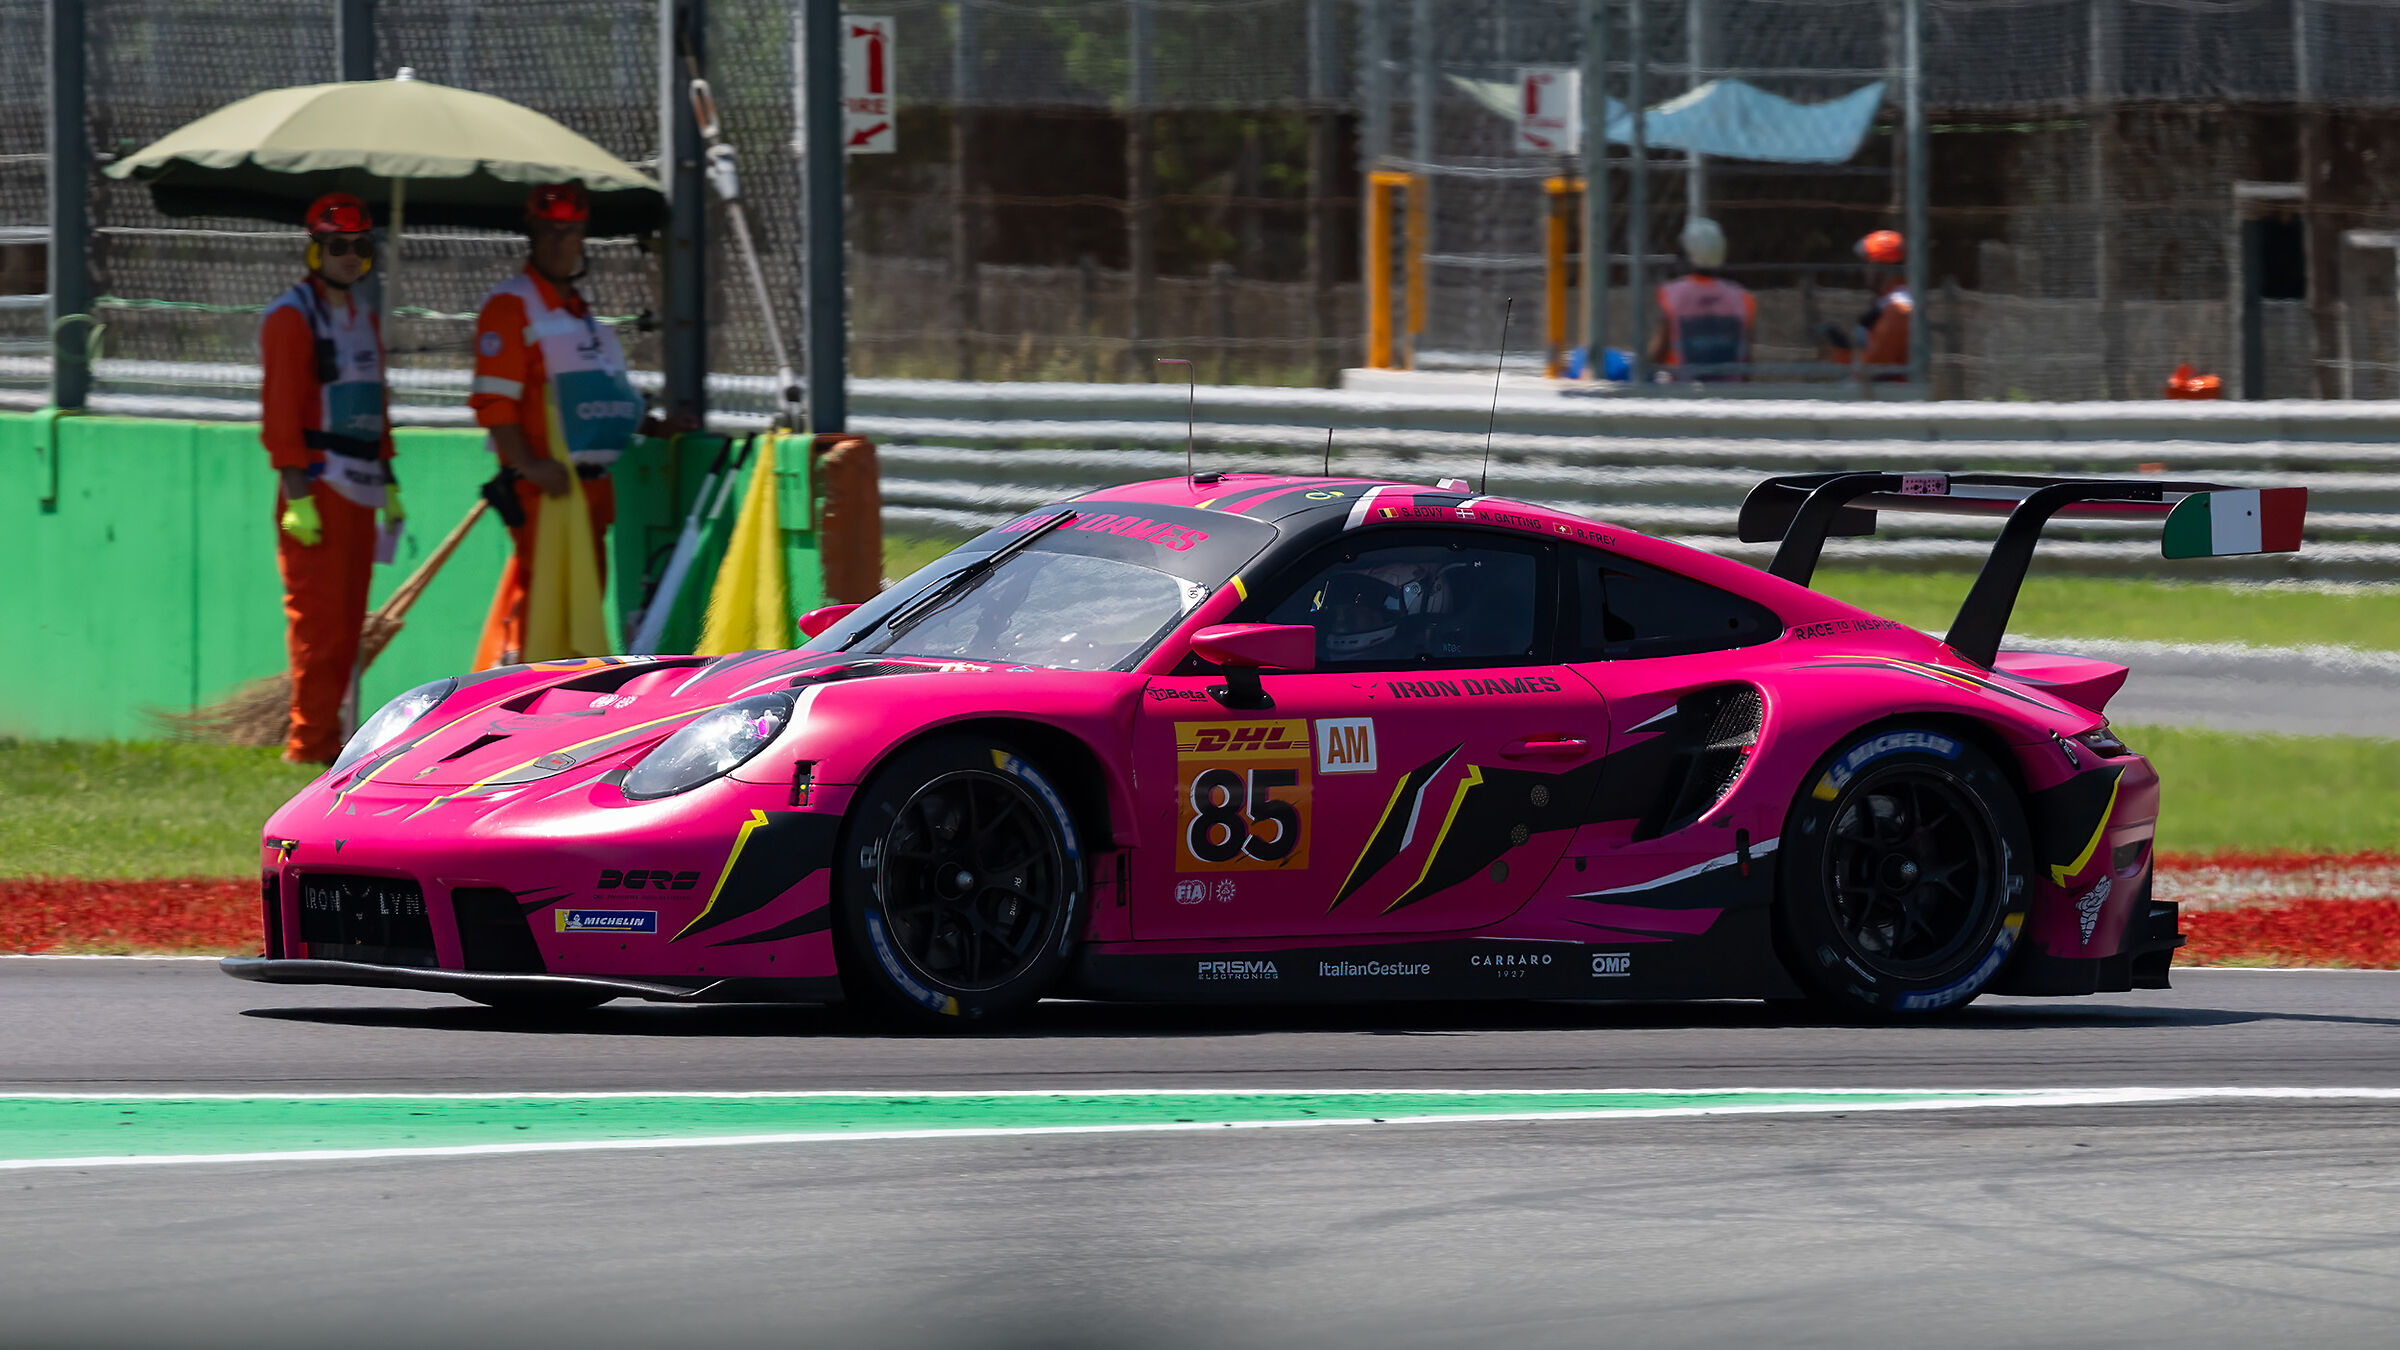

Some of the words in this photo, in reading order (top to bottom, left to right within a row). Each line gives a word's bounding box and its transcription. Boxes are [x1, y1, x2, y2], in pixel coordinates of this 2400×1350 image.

[843, 97, 888, 115] IRE
[1075, 512, 1209, 551] DAMES
[1796, 622, 1834, 641] RACE
[1837, 620, 1850, 631] TO
[1851, 619, 1901, 632] INSPIRE
[1166, 688, 1206, 699] Beta
[1386, 680, 1462, 699] IRON
[1461, 676, 1562, 696] DAMES
[1195, 727, 1293, 752] DHL
[1327, 725, 1370, 764] AM
[1186, 768, 1300, 863] 85
[305, 884, 341, 912] IRON
[584, 916, 645, 926] MICHELIN
[1198, 960, 1278, 973] PRISMA
[1319, 960, 1431, 977] ItalianGesture
[1471, 954, 1552, 966] CARRARO
[1592, 957, 1631, 973] OMP
[1497, 969, 1525, 978] 1927
